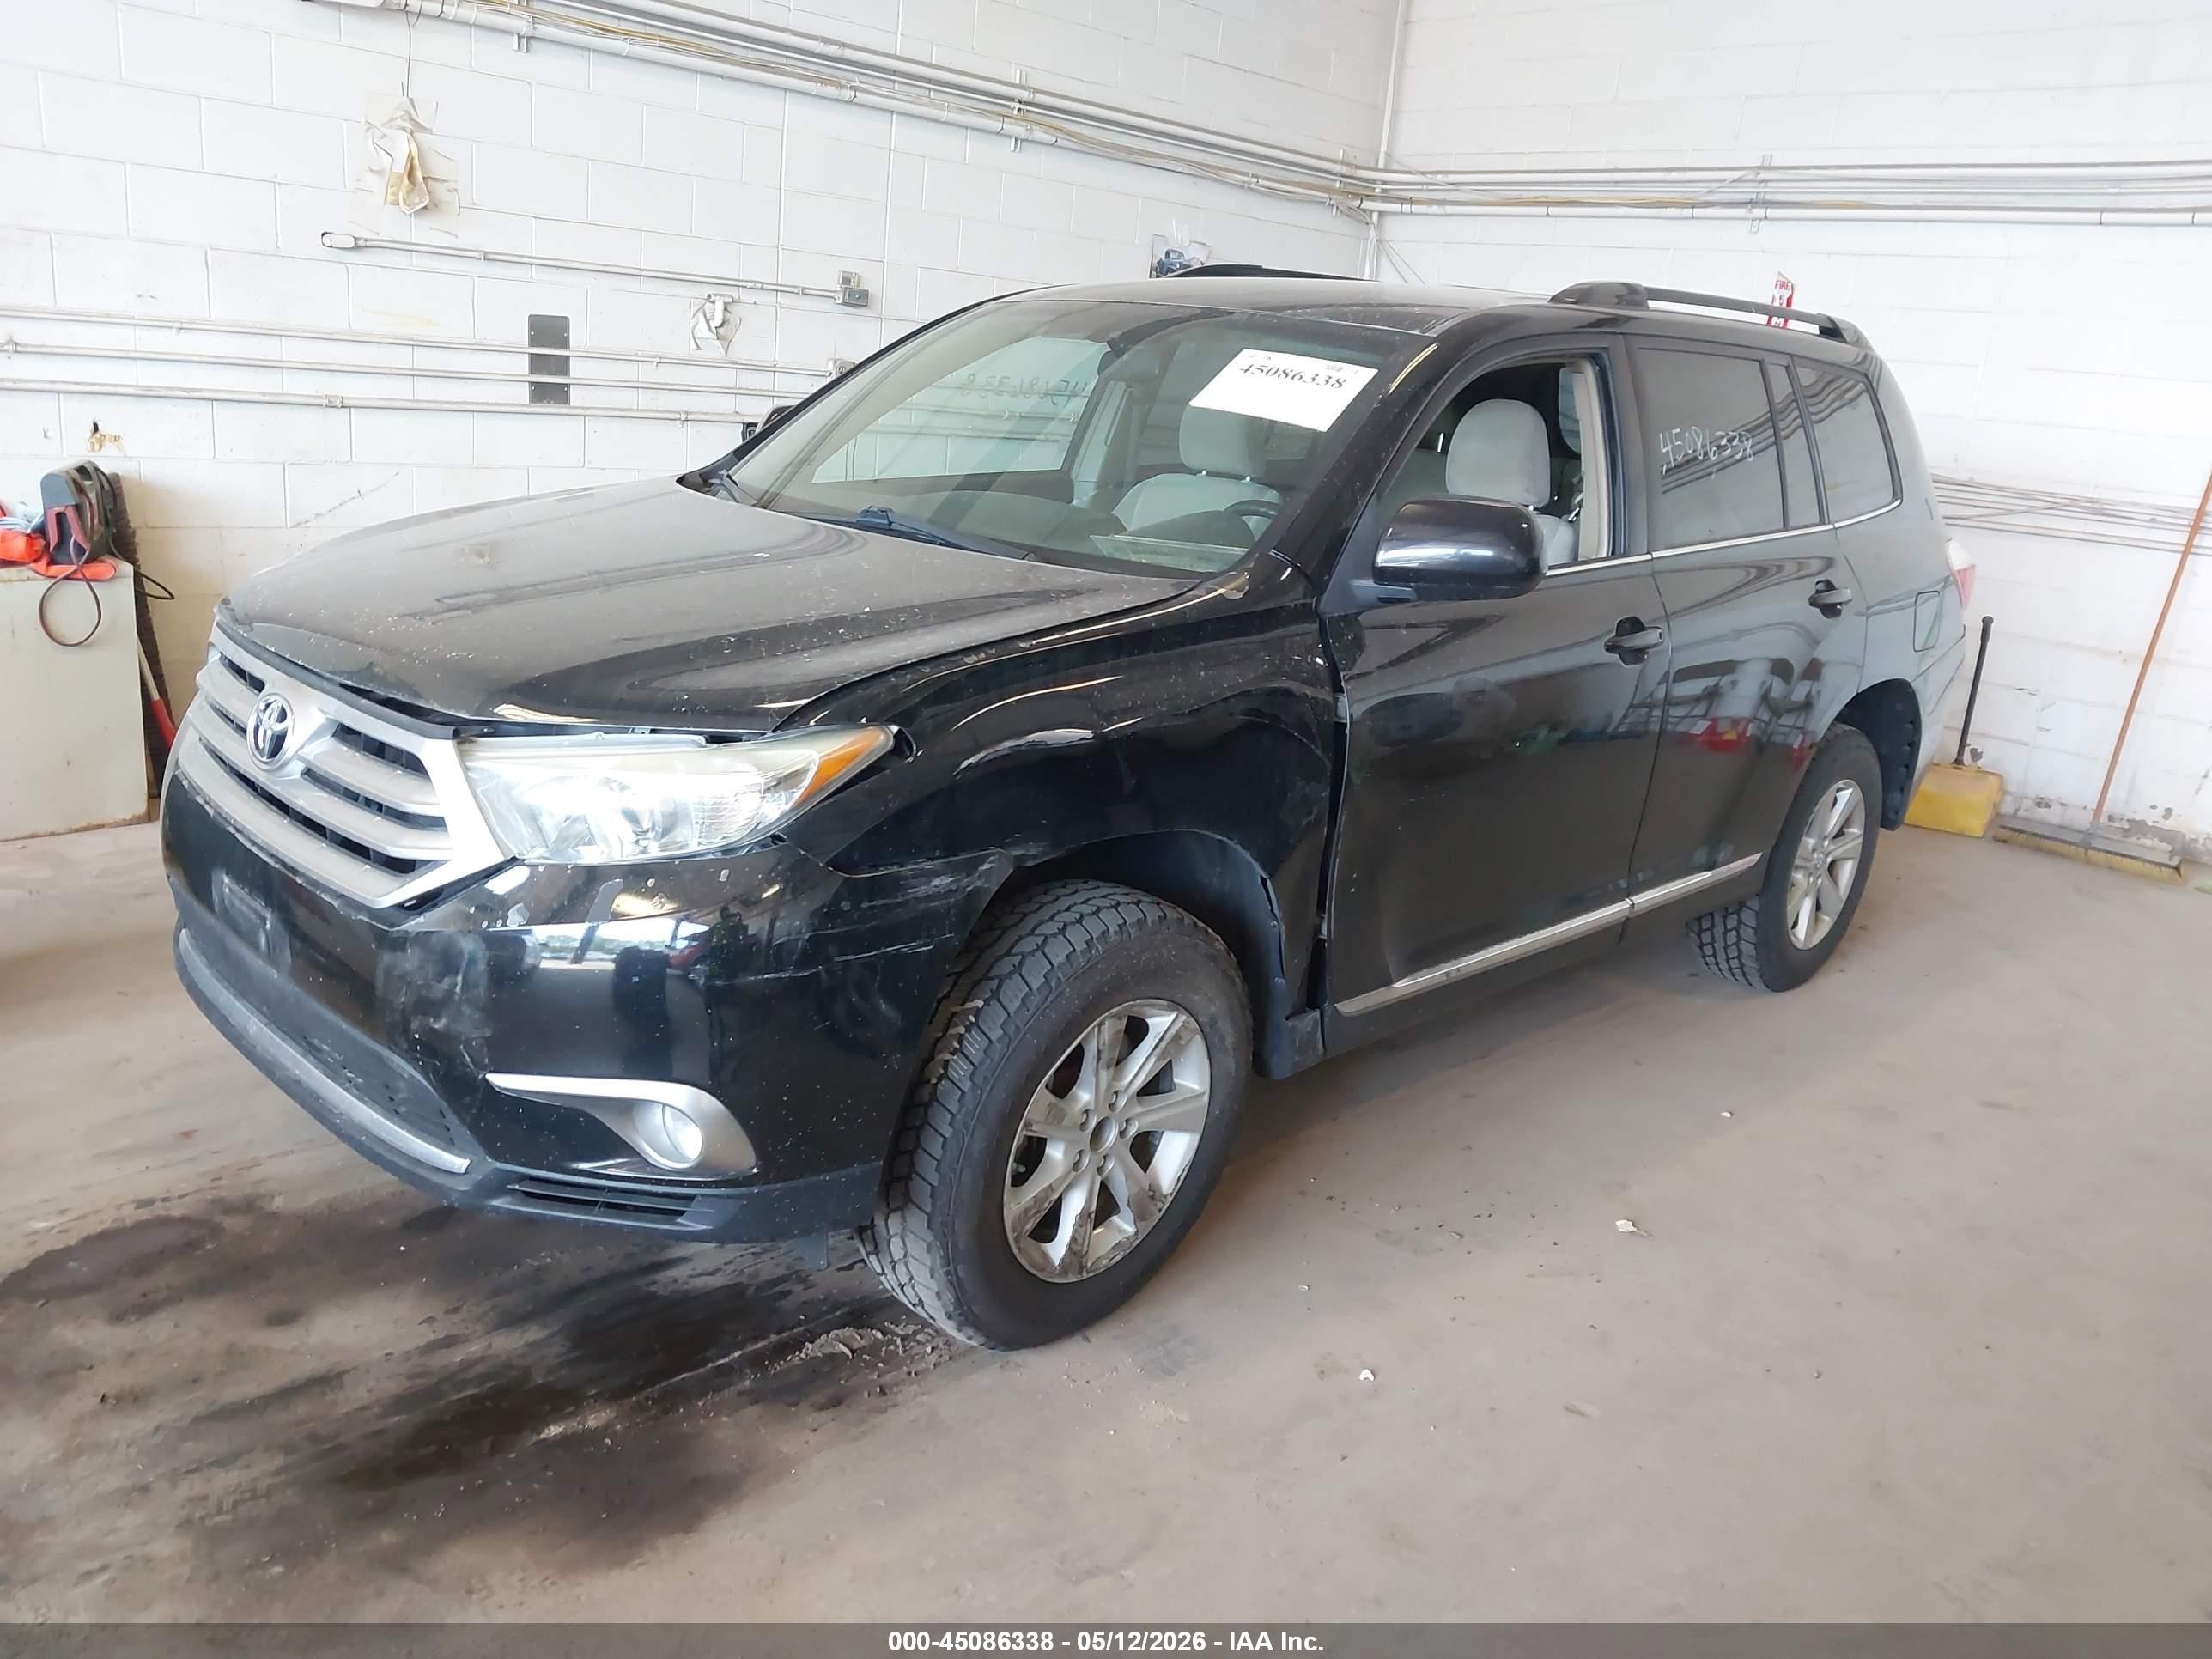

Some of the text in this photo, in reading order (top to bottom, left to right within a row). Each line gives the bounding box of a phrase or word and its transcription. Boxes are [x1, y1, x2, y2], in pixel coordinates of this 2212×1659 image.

[1774, 280, 1791, 290] FIRE
[1239, 363, 1347, 389] 45086338
[1659, 426, 1753, 467] 45086338
